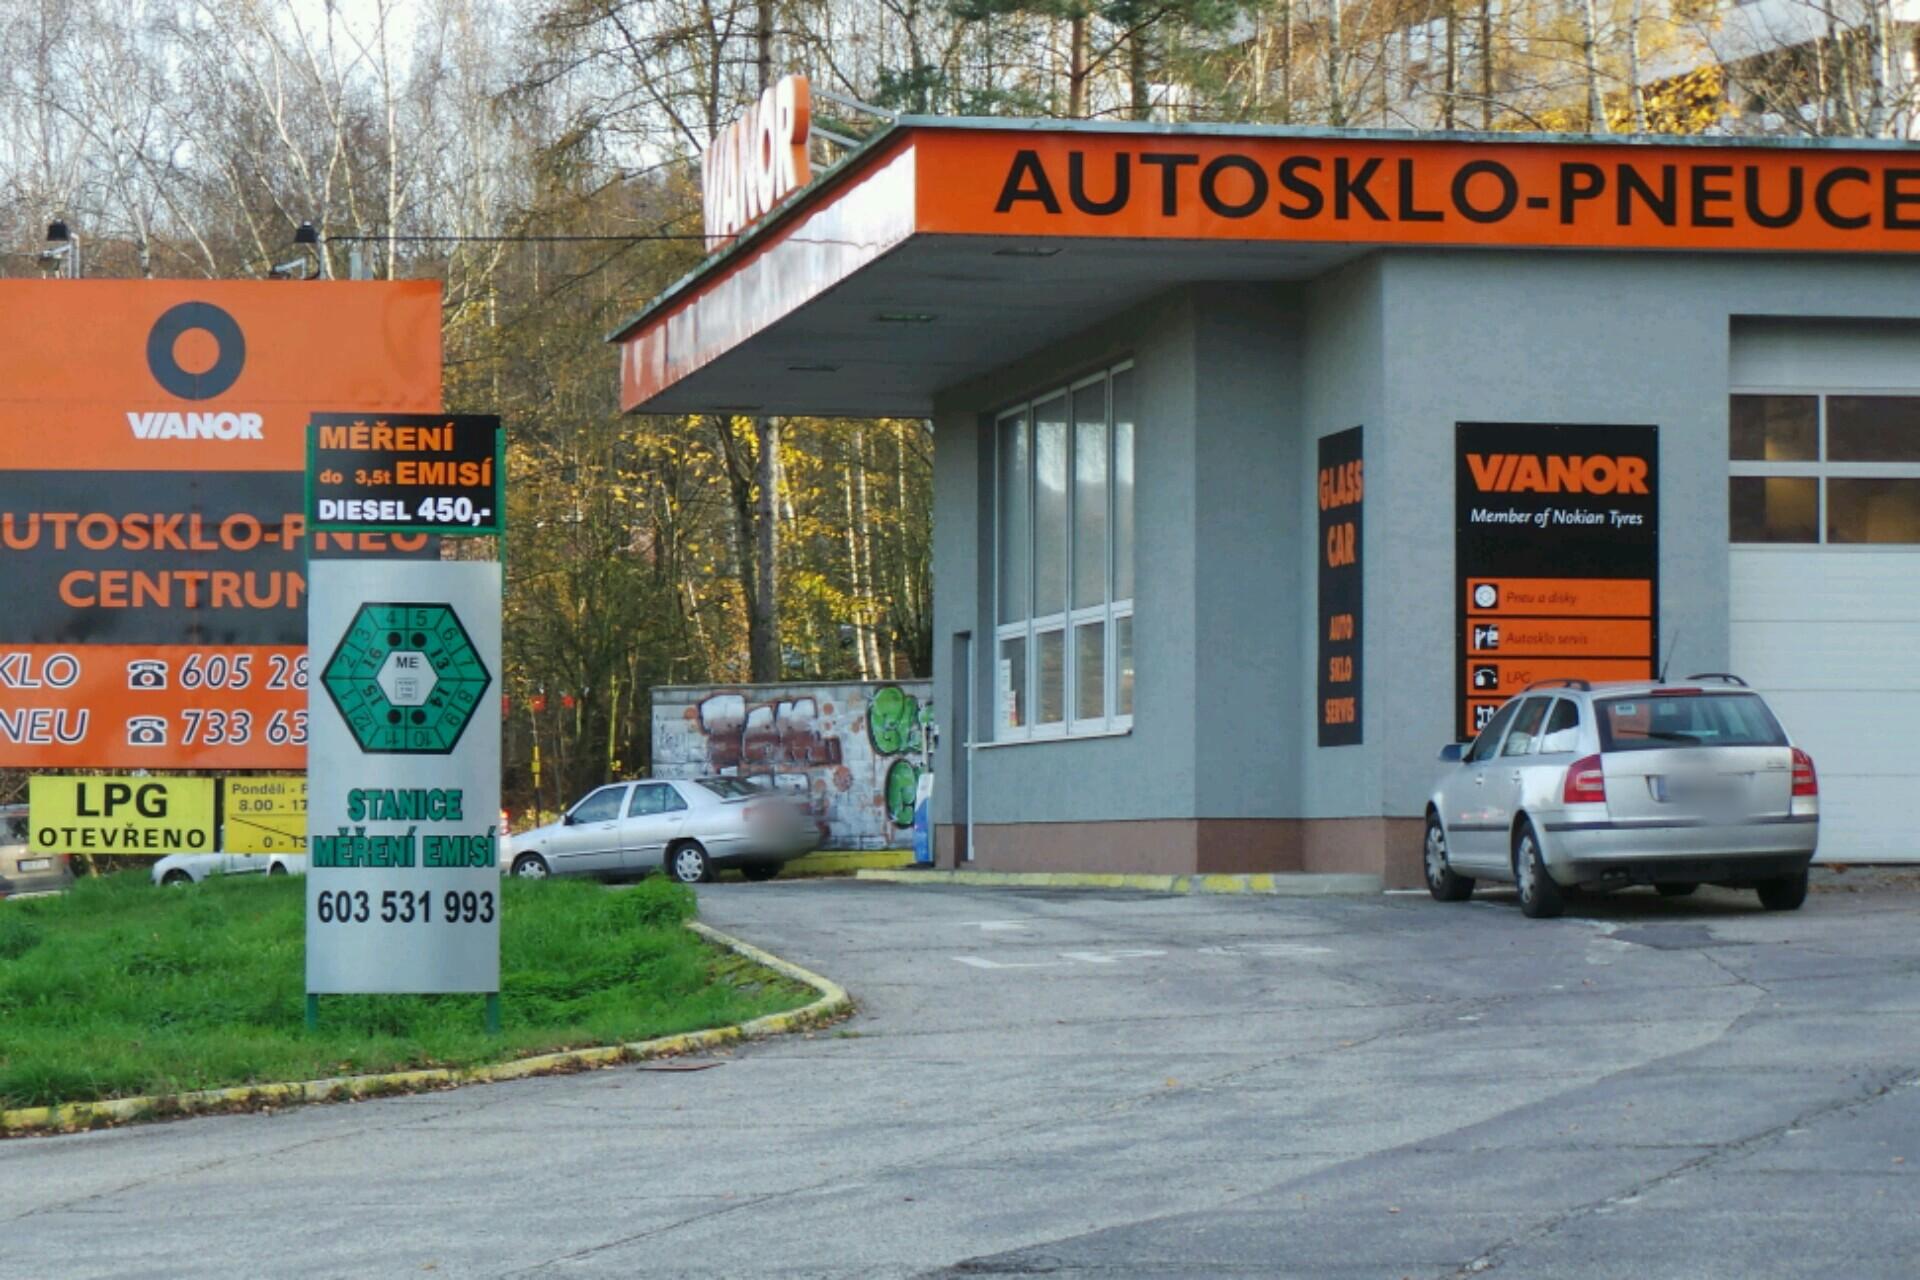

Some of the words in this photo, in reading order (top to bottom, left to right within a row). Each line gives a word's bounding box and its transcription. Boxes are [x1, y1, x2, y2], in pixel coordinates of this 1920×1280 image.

[994, 149, 1920, 231] AUTOSKLO-PNEUCE
[127, 412, 264, 439] VIANOR
[319, 420, 454, 451] MĚŘENÍ
[319, 468, 343, 484] do
[355, 469, 391, 486] 3,5t
[396, 457, 493, 487] EMISÍ
[1320, 459, 1363, 511] GLASS
[1465, 453, 1650, 495] VIANOR
[319, 499, 412, 521] DIESEL
[417, 497, 491, 526] 450,-
[1471, 507, 1531, 524] Member
[1534, 507, 1553, 529] of
[1552, 508, 1604, 525] Nokian
[1609, 510, 1643, 529] Tyres
[1327, 522, 1355, 568] CAR
[387, 610, 397, 624] 4
[416, 610, 428, 626] 5
[355, 627, 371, 640] 3
[1506, 632, 1555, 645] Autosklo
[180, 653, 252, 690] 605
[266, 653, 308, 690] 28
[396, 656, 419, 668] ME
[181, 708, 252, 745] 733
[266, 708, 308, 745] 63
[76, 782, 168, 818] LPG
[347, 788, 463, 821] STANICE
[38, 823, 206, 848] OTEVŘENO
[312, 826, 417, 868] MĚŘENÍ
[423, 826, 496, 868] EMISÍ
[318, 890, 370, 924] 603
[381, 890, 431, 924] 531
[444, 890, 494, 924] 993
